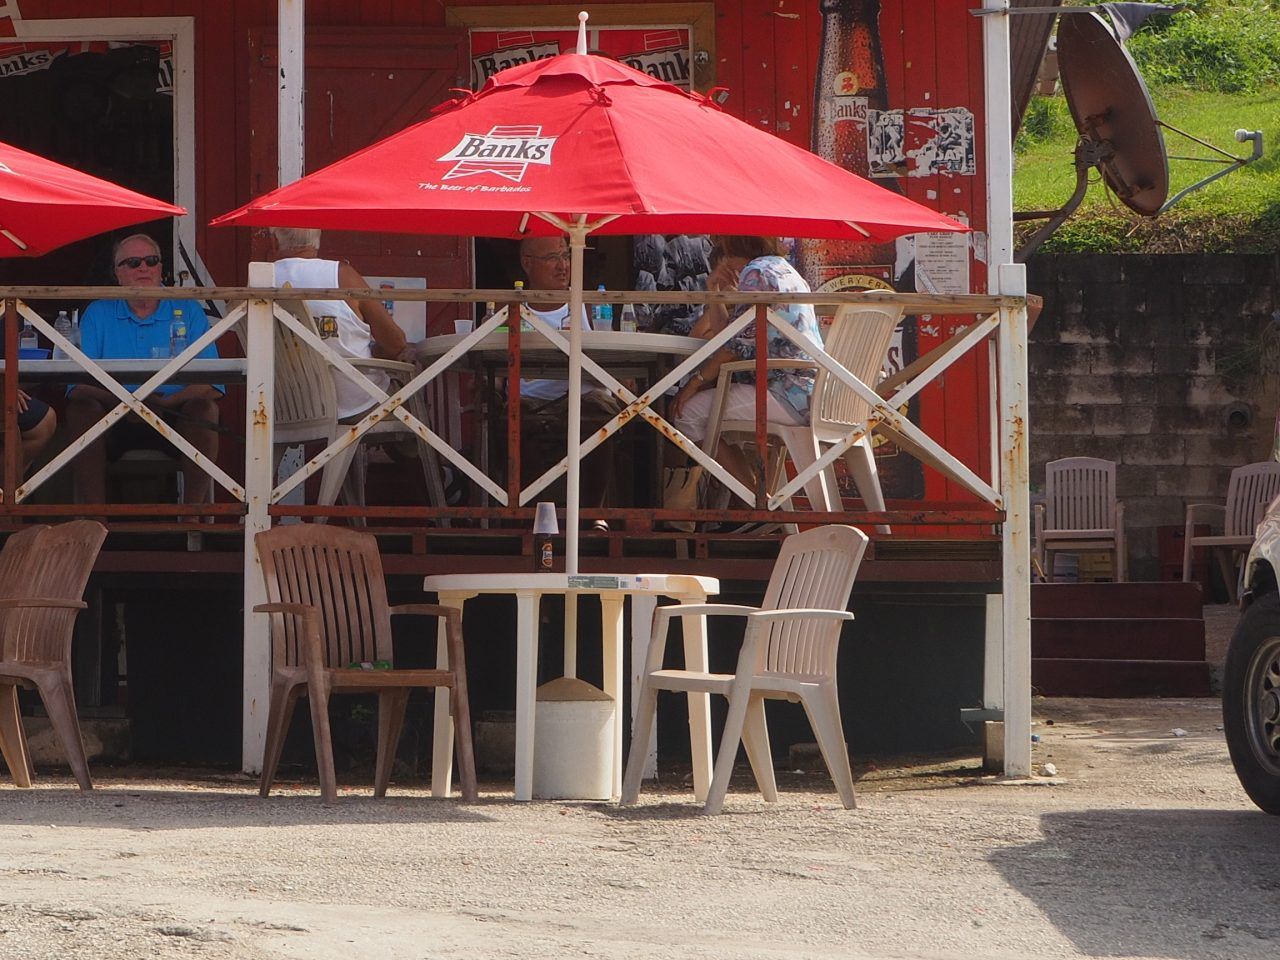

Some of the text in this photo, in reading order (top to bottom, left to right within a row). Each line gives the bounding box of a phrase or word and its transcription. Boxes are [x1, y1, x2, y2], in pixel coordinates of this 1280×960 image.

[478, 49, 558, 81] Bank
[456, 137, 549, 161] Banks
[418, 182, 438, 190] The
[465, 185, 481, 193] of
[480, 185, 533, 193] Barbados
